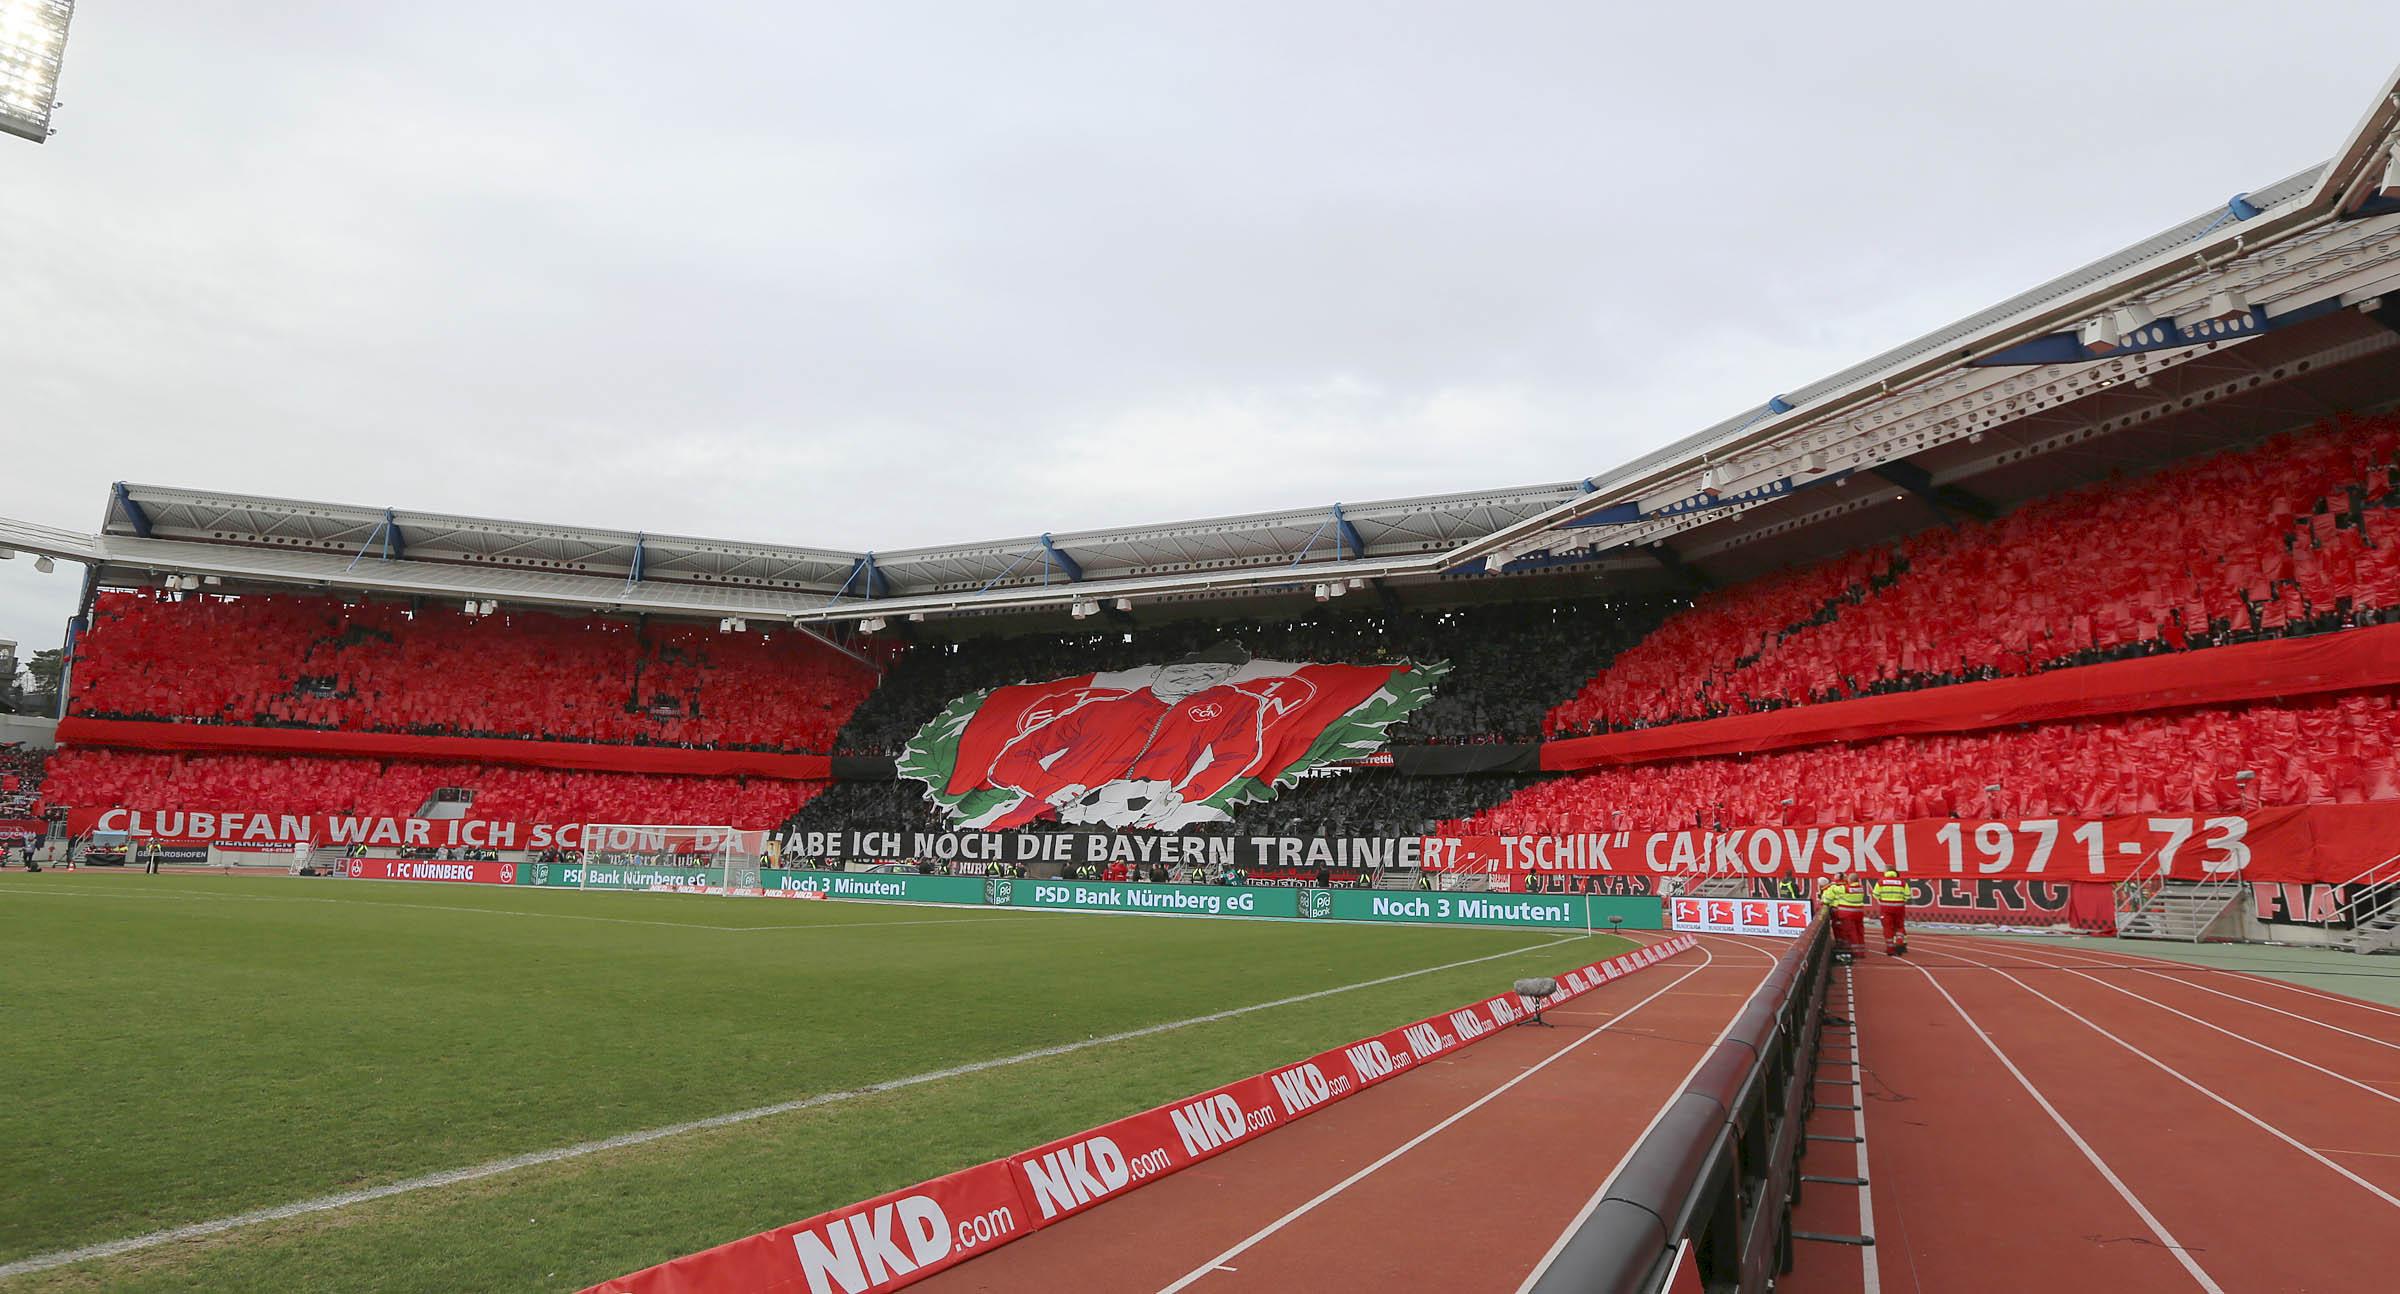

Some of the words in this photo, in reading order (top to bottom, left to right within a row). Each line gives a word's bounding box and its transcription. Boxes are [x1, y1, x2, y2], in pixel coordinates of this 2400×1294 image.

[98, 809, 310, 840] CLUBFAN
[329, 816, 430, 845] WAR
[447, 819, 516, 847] ICH
[694, 829, 744, 852] DA
[852, 831, 901, 857] ICH
[914, 832, 1003, 859] NOCH
[1017, 833, 1074, 861] DIE
[1088, 834, 1235, 864] BAYERN
[1251, 835, 1462, 868] TRAINIERT
[1645, 823, 1909, 875] CAJKOVSKI
[1936, 816, 2251, 875] 1971-73
[397, 863, 410, 878] FC
[412, 861, 473, 880] NÜRNBERG
[589, 869, 620, 884] Bank
[687, 874, 706, 887] eG
[780, 876, 817, 892] Noch
[822, 878, 830, 893] 3
[835, 878, 906, 896] Minuten!
[1035, 887, 1070, 903] PSD
[1076, 887, 1121, 906] Bank
[1127, 889, 1221, 914] Nürnberg
[1227, 893, 1254, 911] eG
[1373, 897, 1430, 917] Noch
[1437, 899, 1450, 918] 3
[1458, 900, 1570, 922] Minuten!
[1403, 1023, 1457, 1060] NKD.com
[1345, 1040, 1412, 1084] NKD.com
[1271, 1063, 1351, 1116] NKD.com
[1170, 1093, 1276, 1157] NKD.com
[1023, 1136, 1172, 1220] NKD.com
[793, 1195, 1015, 1294] NKD.com
